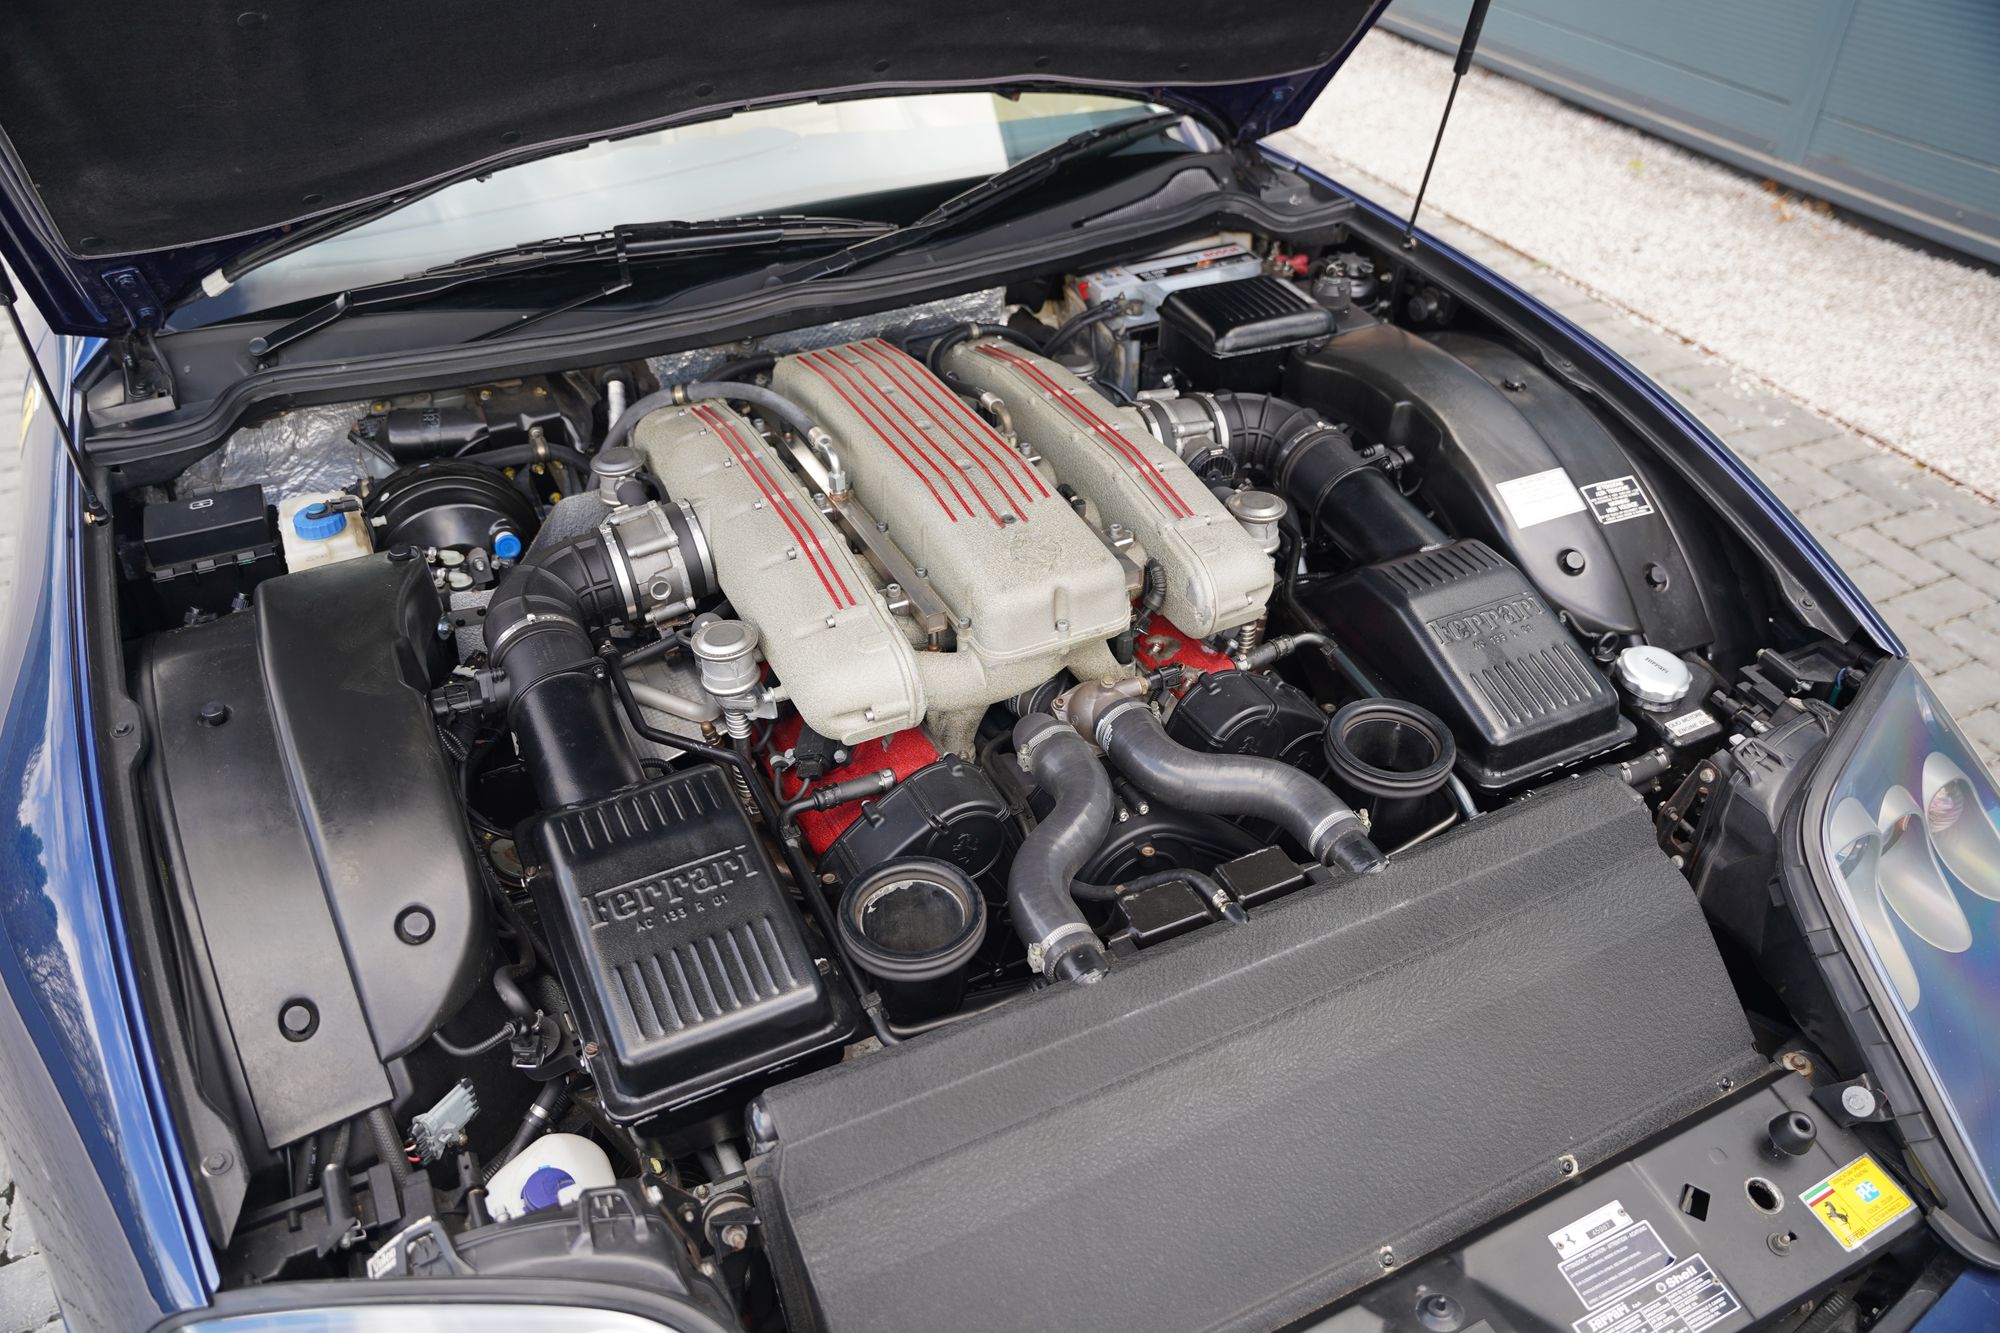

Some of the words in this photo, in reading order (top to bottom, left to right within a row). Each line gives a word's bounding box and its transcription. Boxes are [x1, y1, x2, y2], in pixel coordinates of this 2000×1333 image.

[1424, 592, 1546, 646] Ferrari
[582, 845, 758, 930] Ferrari
[636, 918, 654, 932] AC
[695, 902, 705, 912] R
[1666, 1265, 1698, 1288] Shell
[1587, 1301, 1630, 1332] Ferrari
